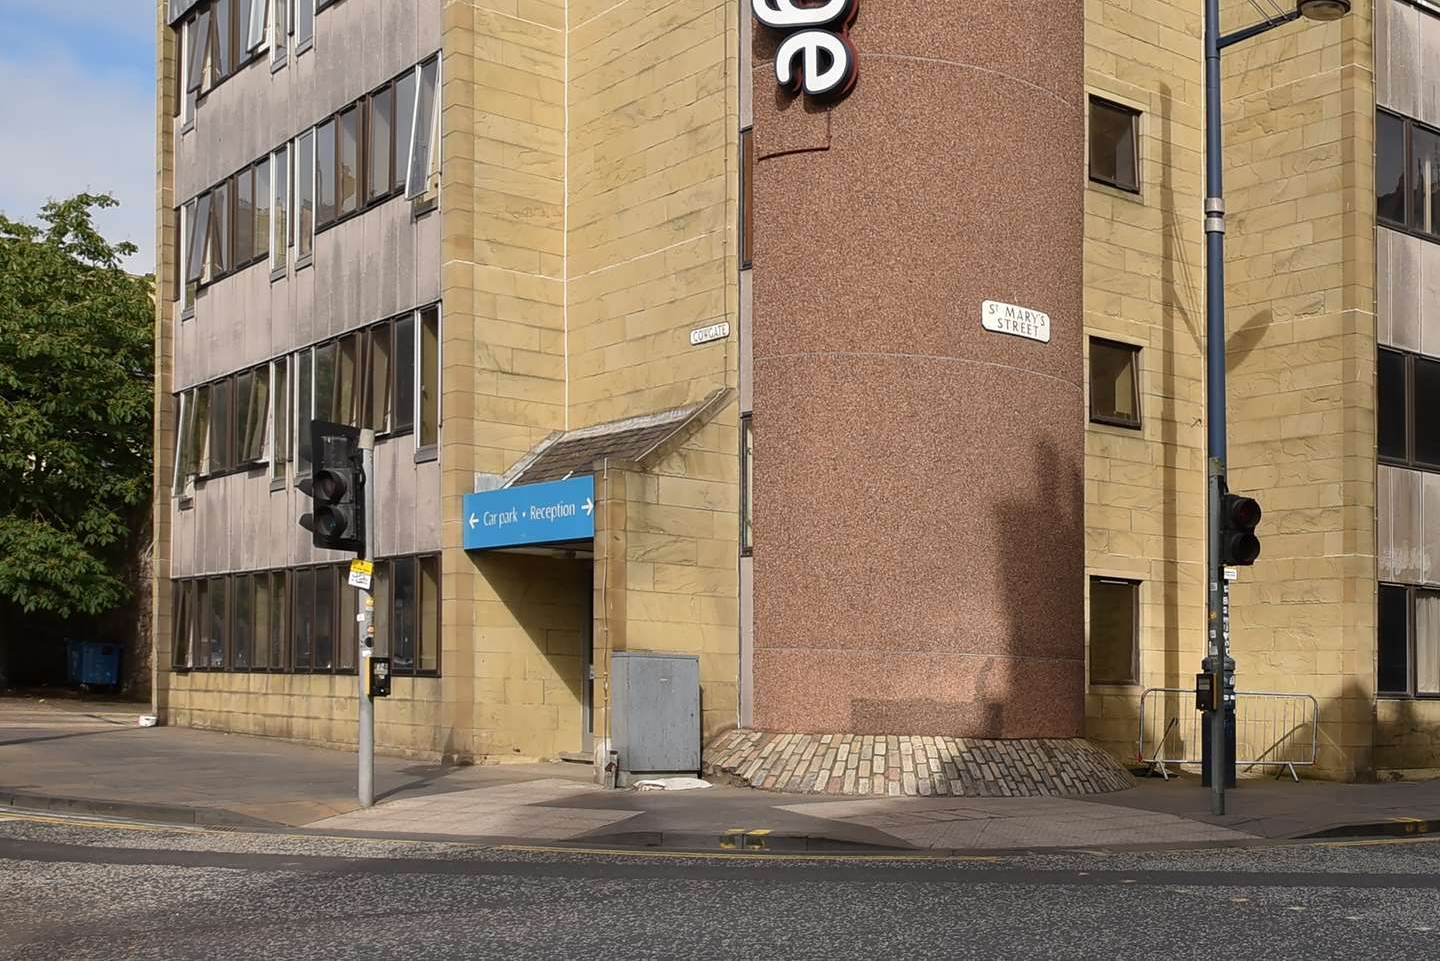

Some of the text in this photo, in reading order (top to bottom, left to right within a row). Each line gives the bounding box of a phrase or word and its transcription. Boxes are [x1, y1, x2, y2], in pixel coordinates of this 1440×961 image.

[1005, 306, 1045, 326] MARY'S
[997, 318, 1039, 336] STREET
[483, 500, 576, 528] Car park Reception
